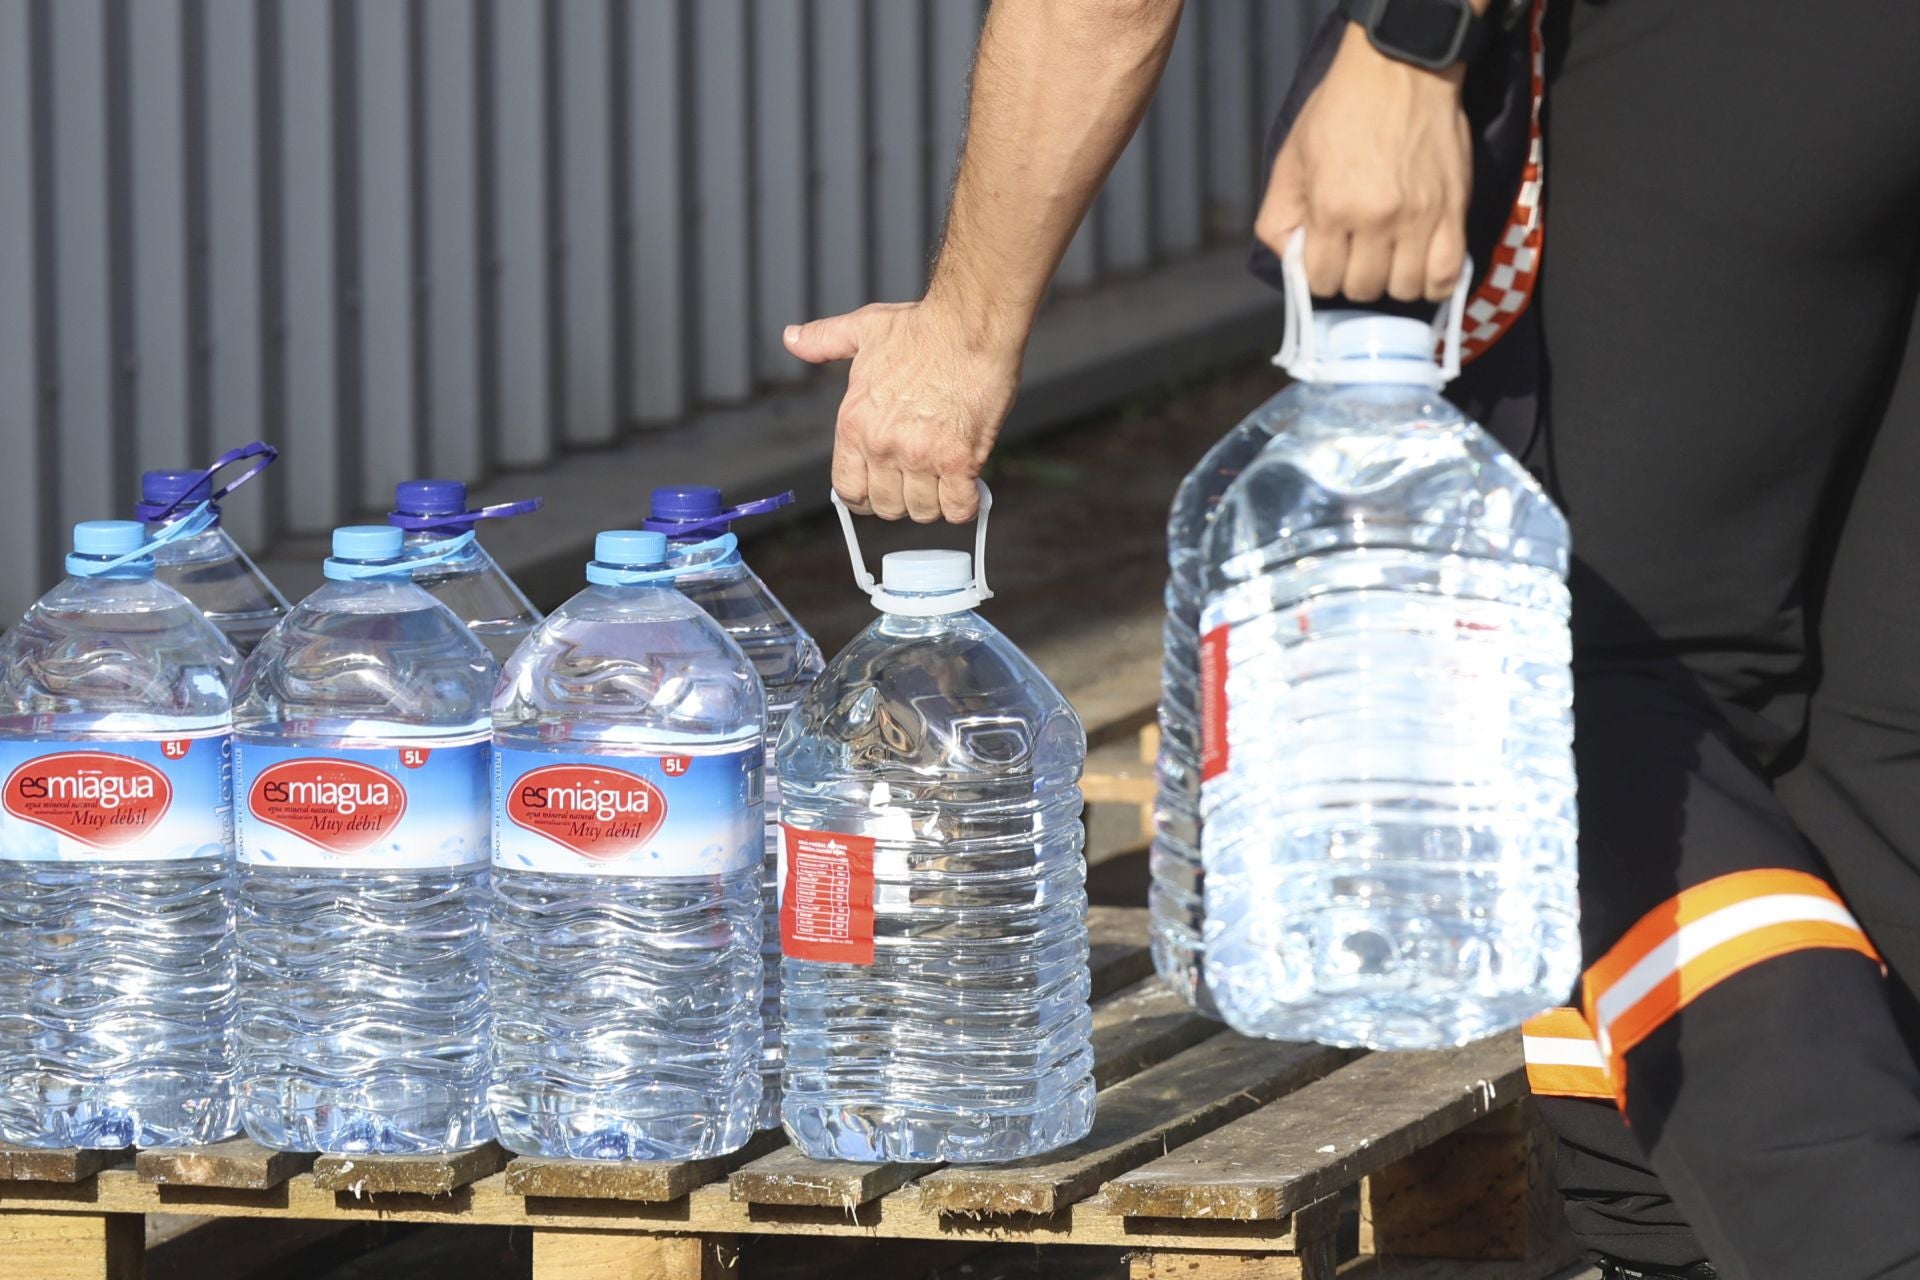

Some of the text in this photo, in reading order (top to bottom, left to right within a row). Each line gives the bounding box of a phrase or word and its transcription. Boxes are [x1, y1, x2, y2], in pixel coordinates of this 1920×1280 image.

[166, 741, 185, 756] 5L
[405, 751, 423, 764] 5L
[666, 759, 684, 772] 5L
[20, 770, 154, 809] esmiagua
[263, 776, 389, 815] esmiagua
[522, 782, 649, 821] esmiagua
[70, 808, 147, 830] Muy débil
[310, 815, 382, 835] Muy débil
[568, 821, 641, 841] Muy débil
